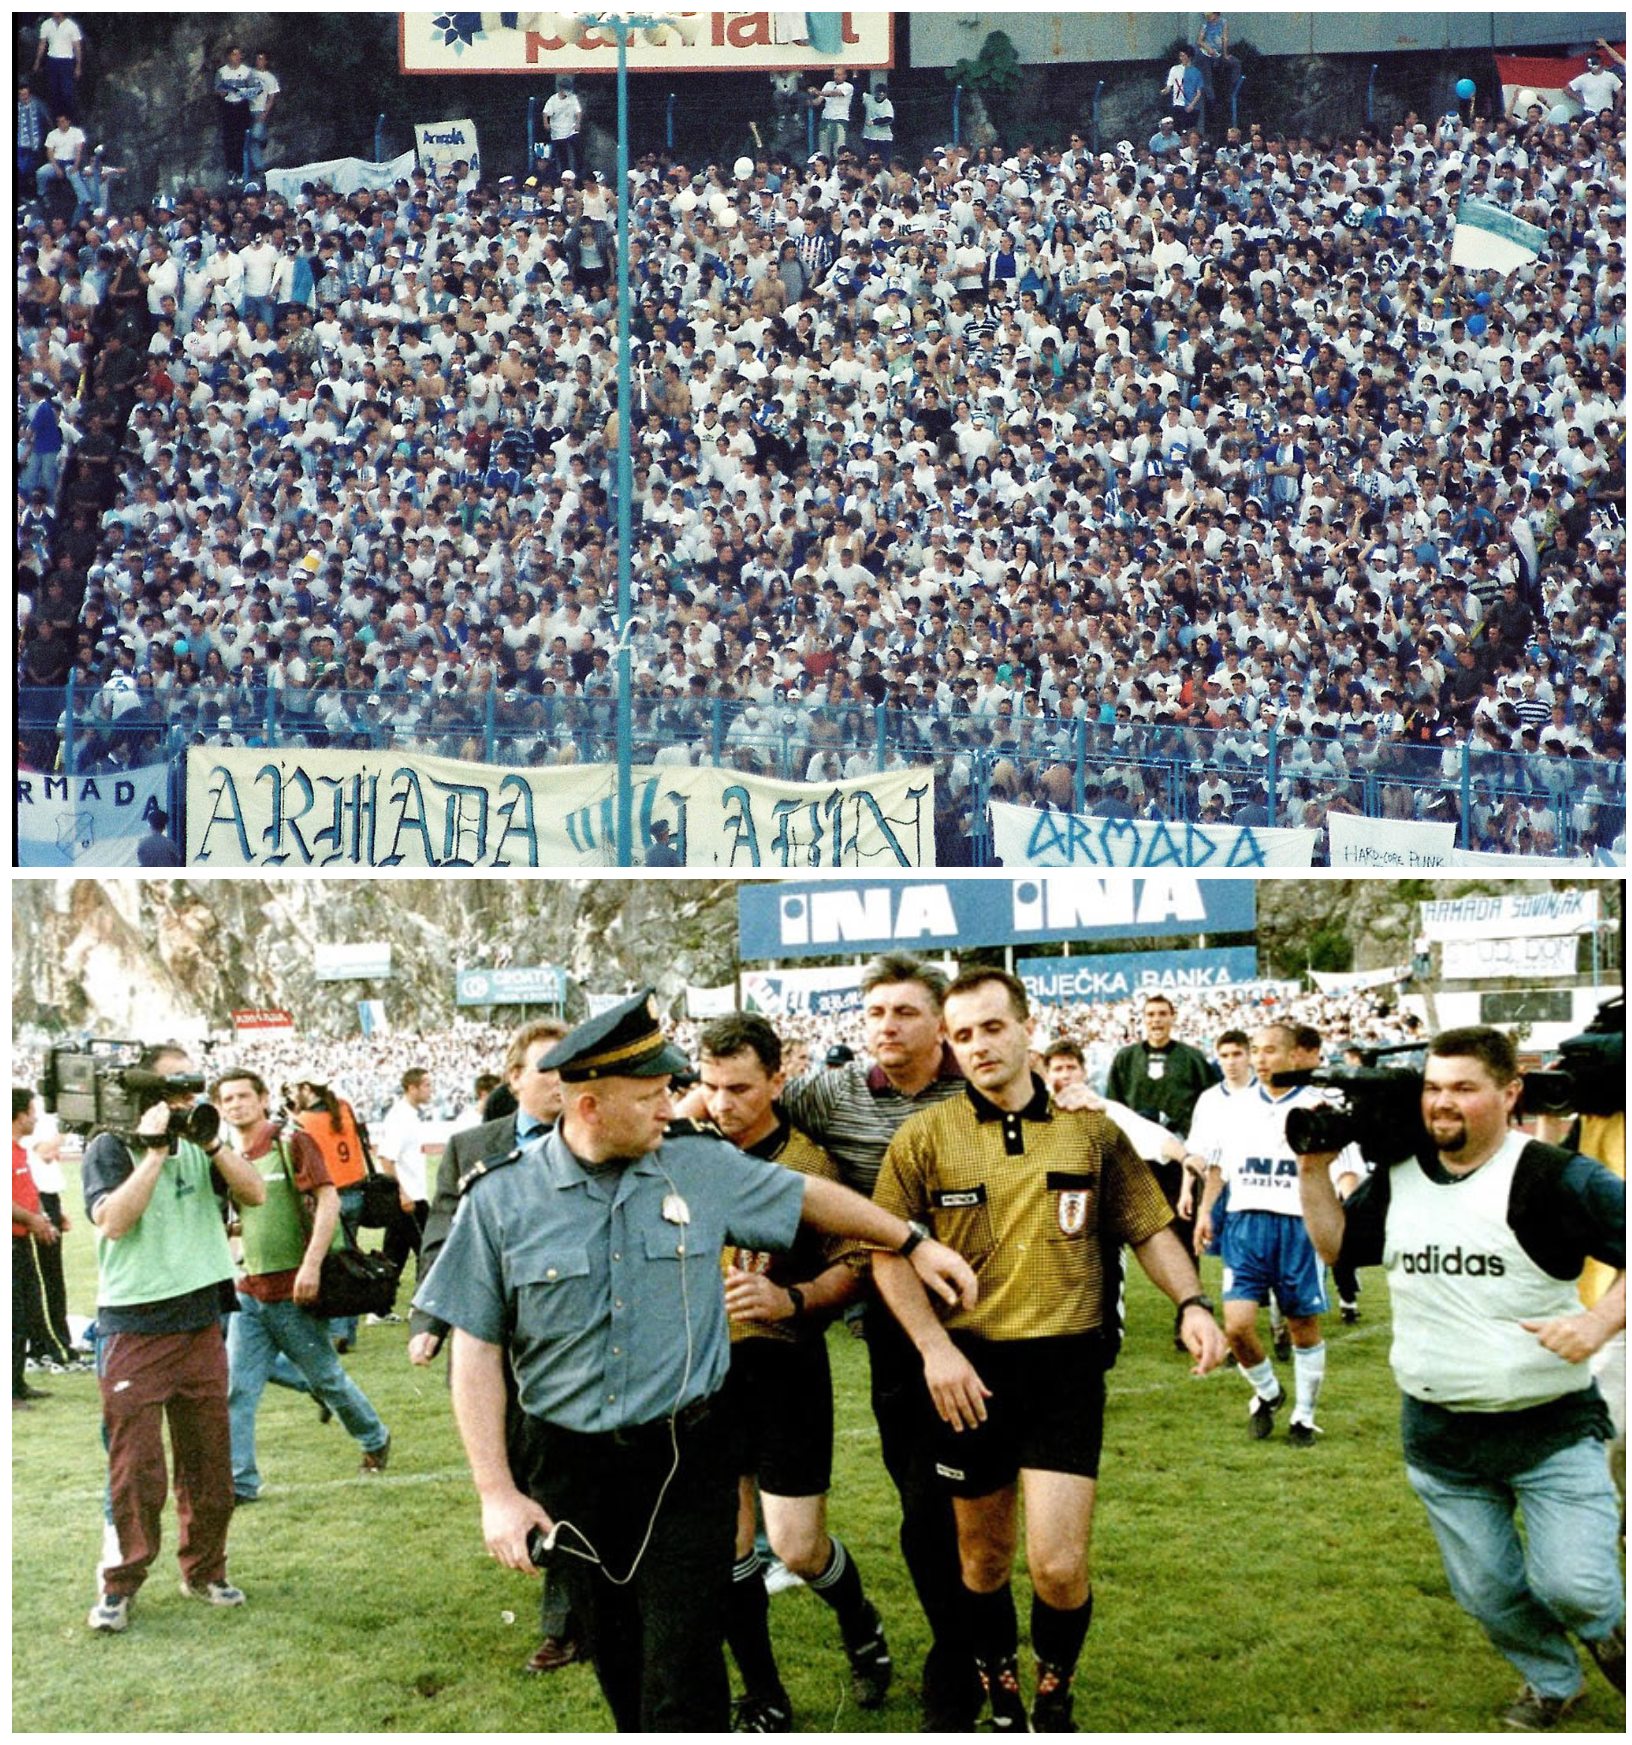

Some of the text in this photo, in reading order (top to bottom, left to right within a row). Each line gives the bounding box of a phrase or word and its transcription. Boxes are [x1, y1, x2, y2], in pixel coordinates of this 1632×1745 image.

[195, 761, 539, 867] ARMADA
[1026, 811, 1266, 867] ARMADA
[1409, 851, 1443, 867] PUNK
[1424, 899, 1500, 922] ARMADA
[1023, 966, 1128, 998] RIJEČKA
[337, 1142, 350, 1163] 9
[1403, 1245, 1506, 1277] adidas
